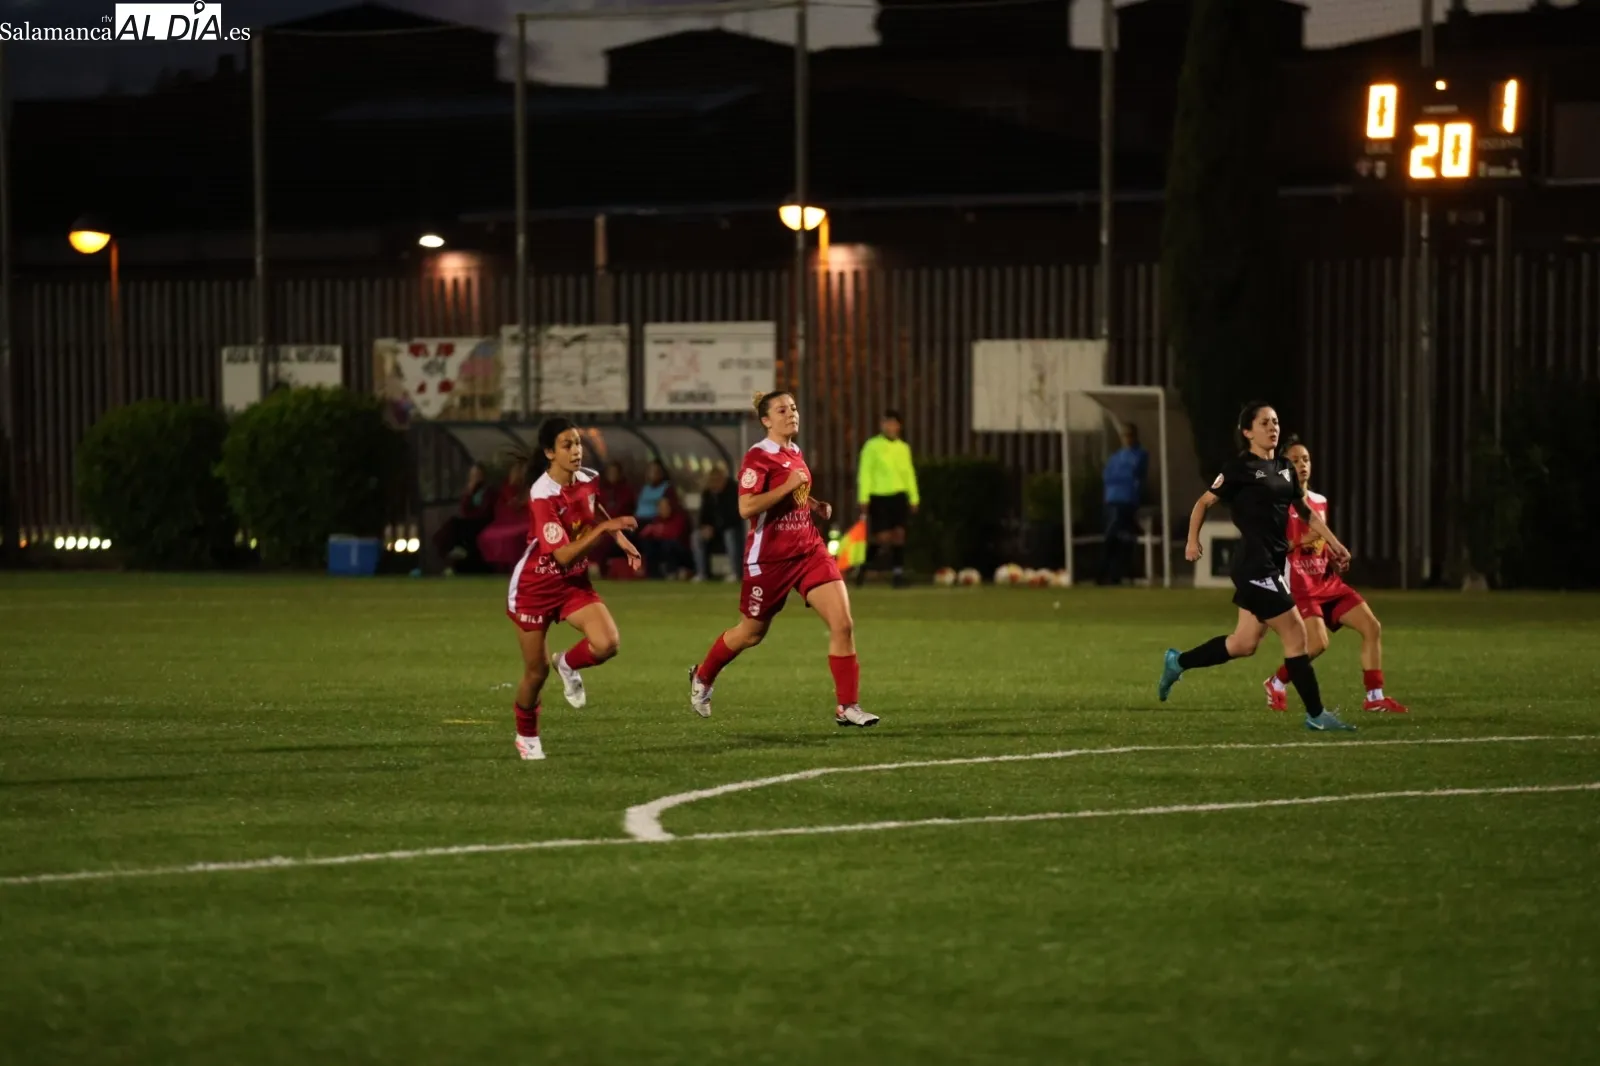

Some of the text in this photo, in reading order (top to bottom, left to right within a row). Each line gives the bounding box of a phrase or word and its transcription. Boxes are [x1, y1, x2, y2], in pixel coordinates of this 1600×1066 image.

[1366, 83, 1398, 139] 0
[1502, 78, 1518, 134] 1
[1409, 122, 1473, 179] 20
